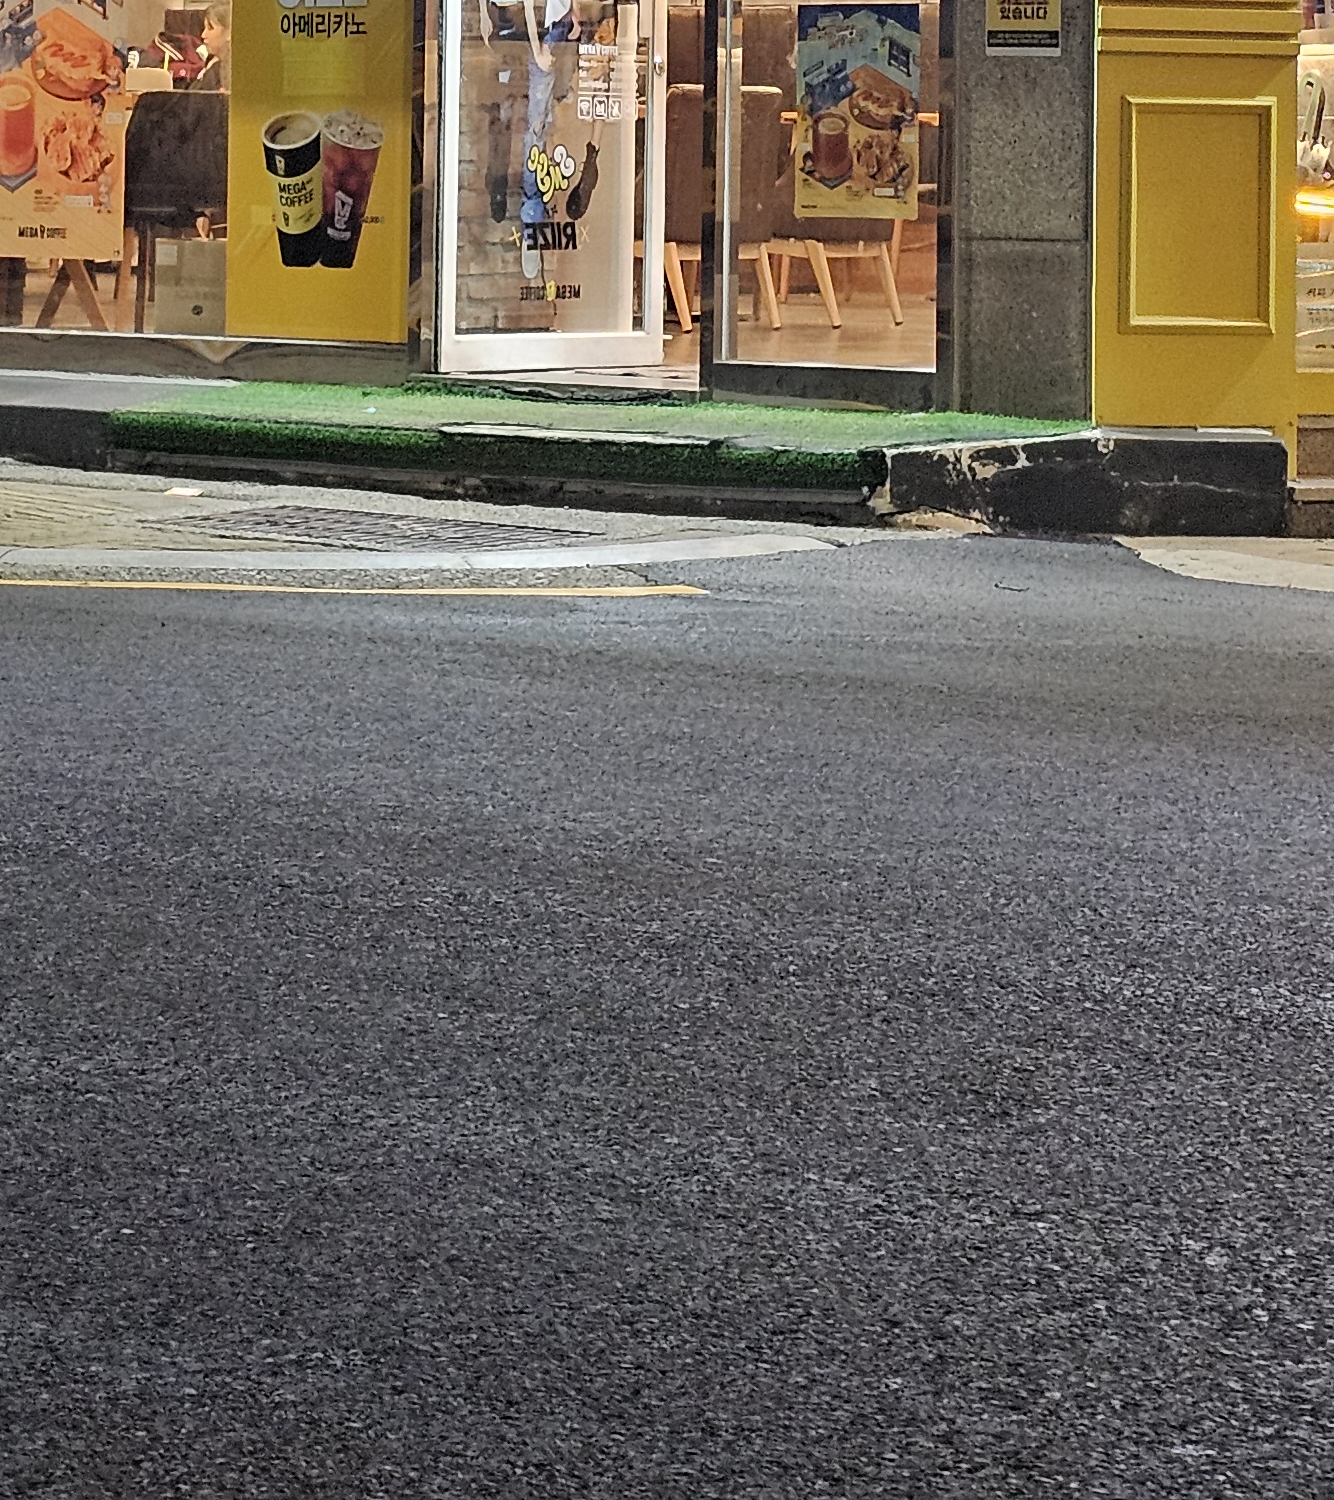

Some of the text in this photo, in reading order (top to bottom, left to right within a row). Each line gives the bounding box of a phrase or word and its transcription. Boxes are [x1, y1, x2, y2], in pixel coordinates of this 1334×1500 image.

[1000, 6, 1048, 20] 있습니다
[280, 12, 368, 38] 아메리카노
[278, 181, 307, 195] MEGA
[280, 188, 314, 208] COFFEE
